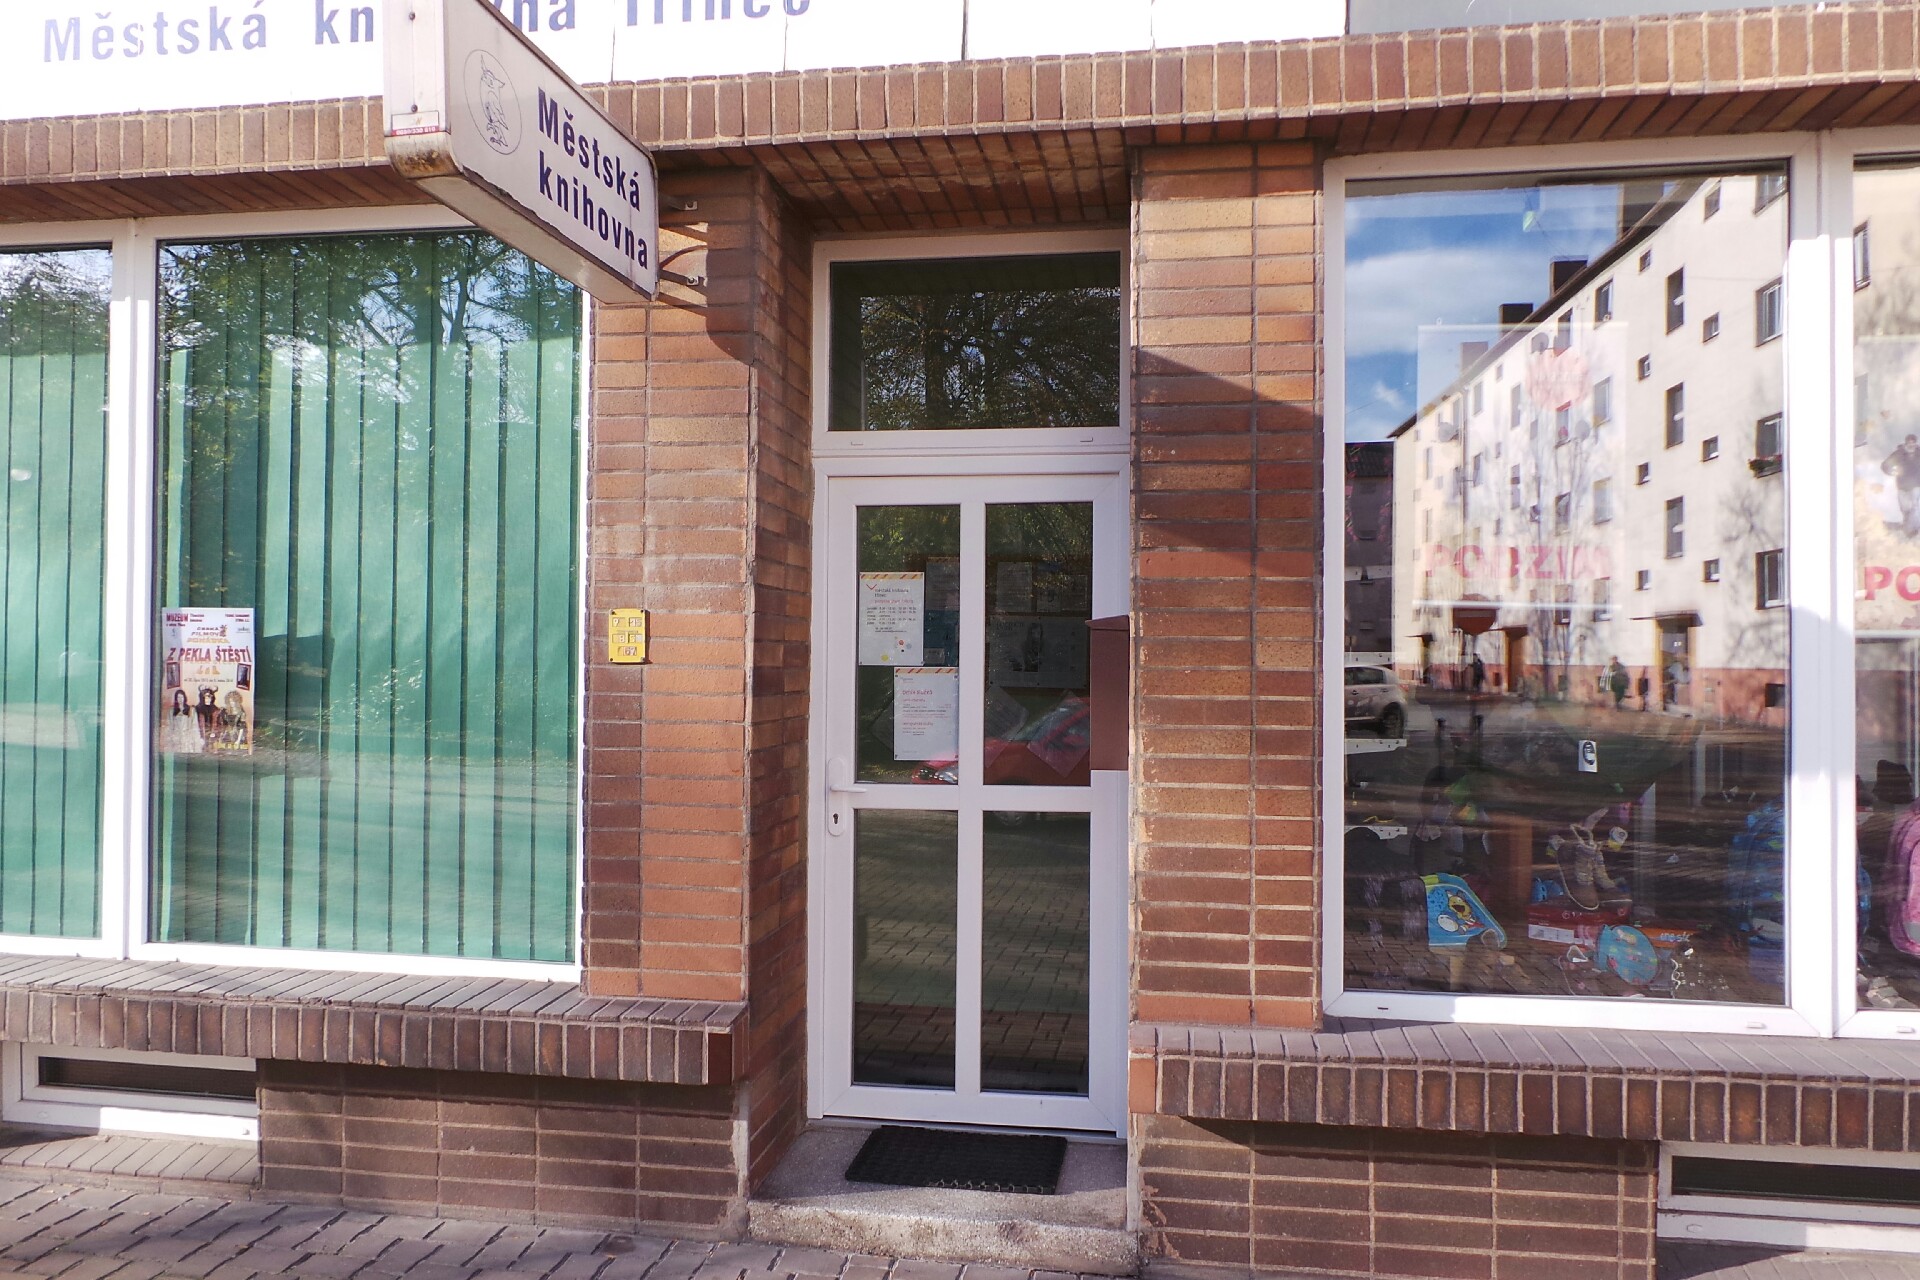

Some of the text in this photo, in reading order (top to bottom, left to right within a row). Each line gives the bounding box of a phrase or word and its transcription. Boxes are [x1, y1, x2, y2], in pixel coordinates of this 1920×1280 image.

[43, 0, 267, 63] Městská
[537, 86, 641, 213] Městská
[538, 150, 649, 270] knihovna
[167, 645, 252, 663] Z PEKLA ŠTĚSTÍ
